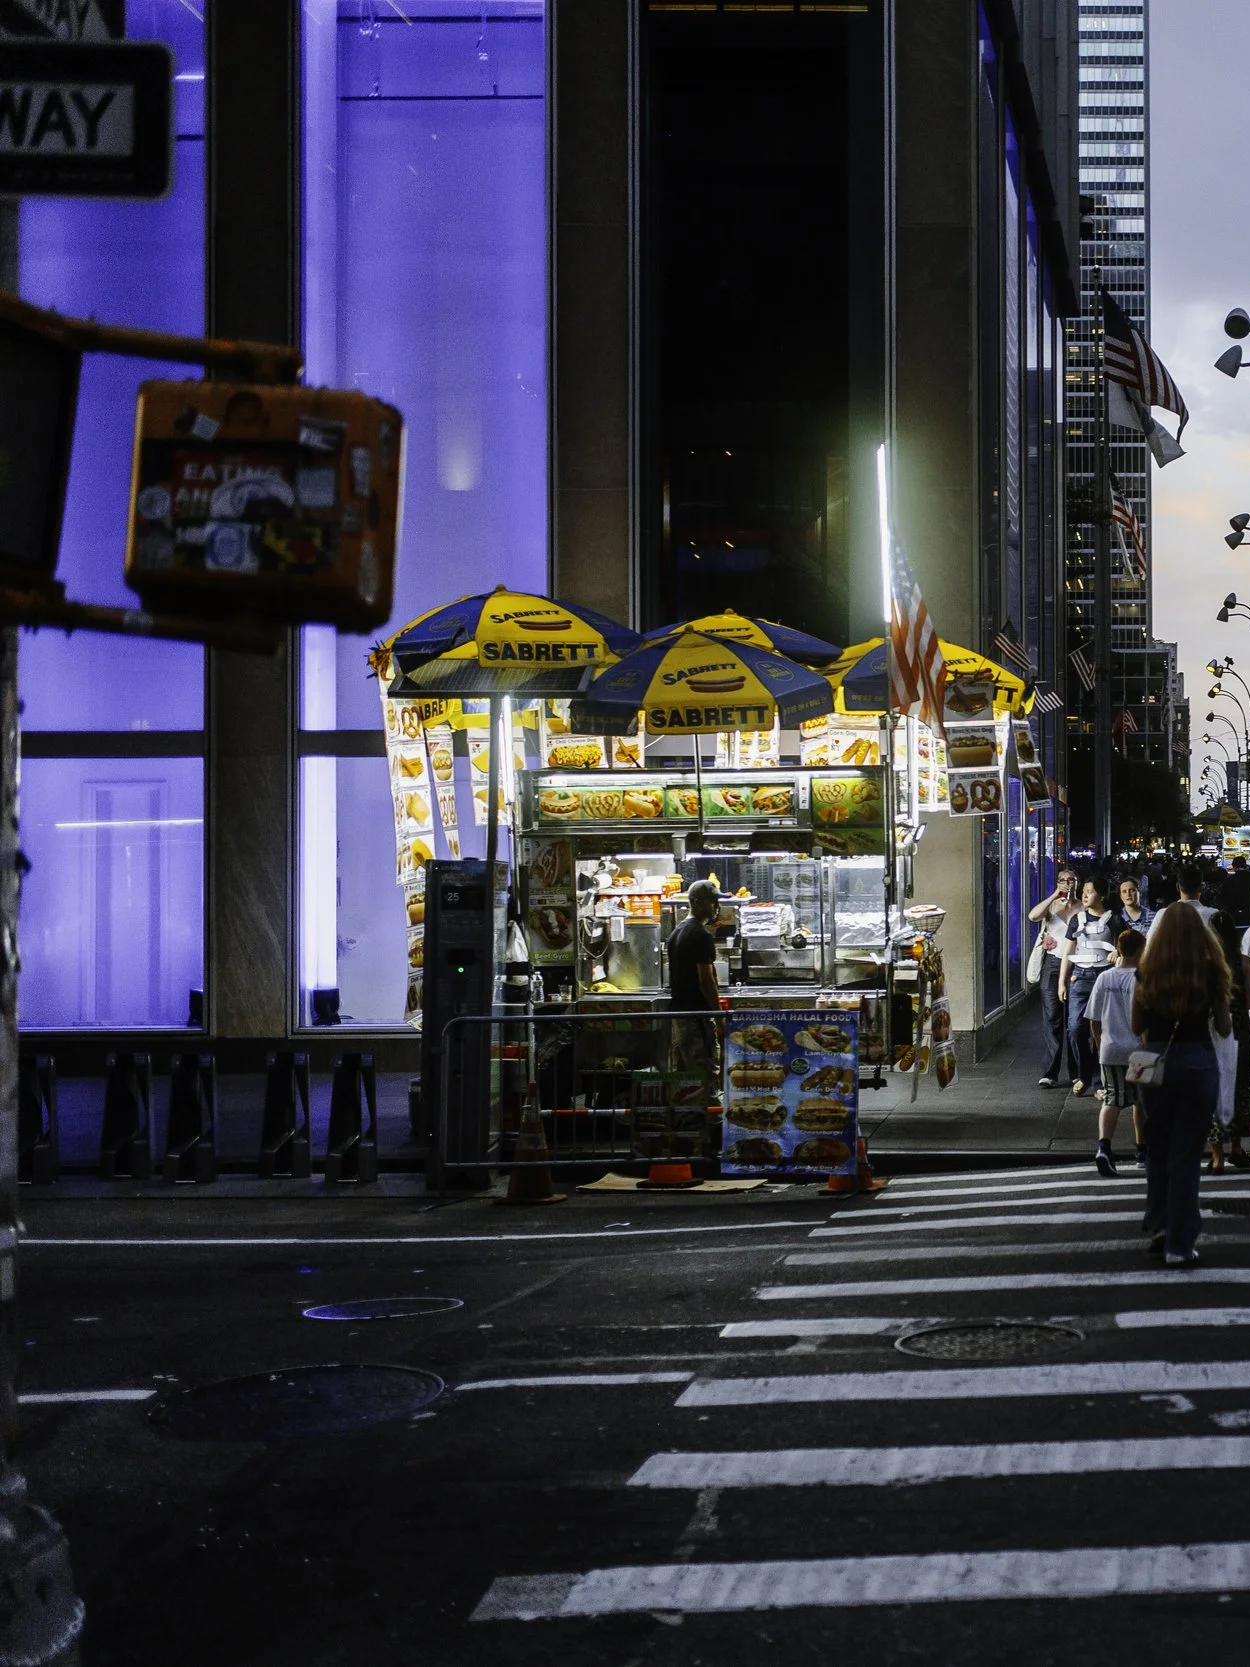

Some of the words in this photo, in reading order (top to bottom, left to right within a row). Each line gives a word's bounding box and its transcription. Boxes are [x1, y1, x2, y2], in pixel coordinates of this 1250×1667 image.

[490, 610, 560, 624] SABRETT
[483, 642, 598, 661] SABRETT
[662, 663, 736, 686] SABRETT
[649, 705, 768, 728] SABRETT
[447, 892, 459, 902] 25
[790, 1013, 822, 1021] HALAL
[825, 1013, 852, 1021] FOOD
